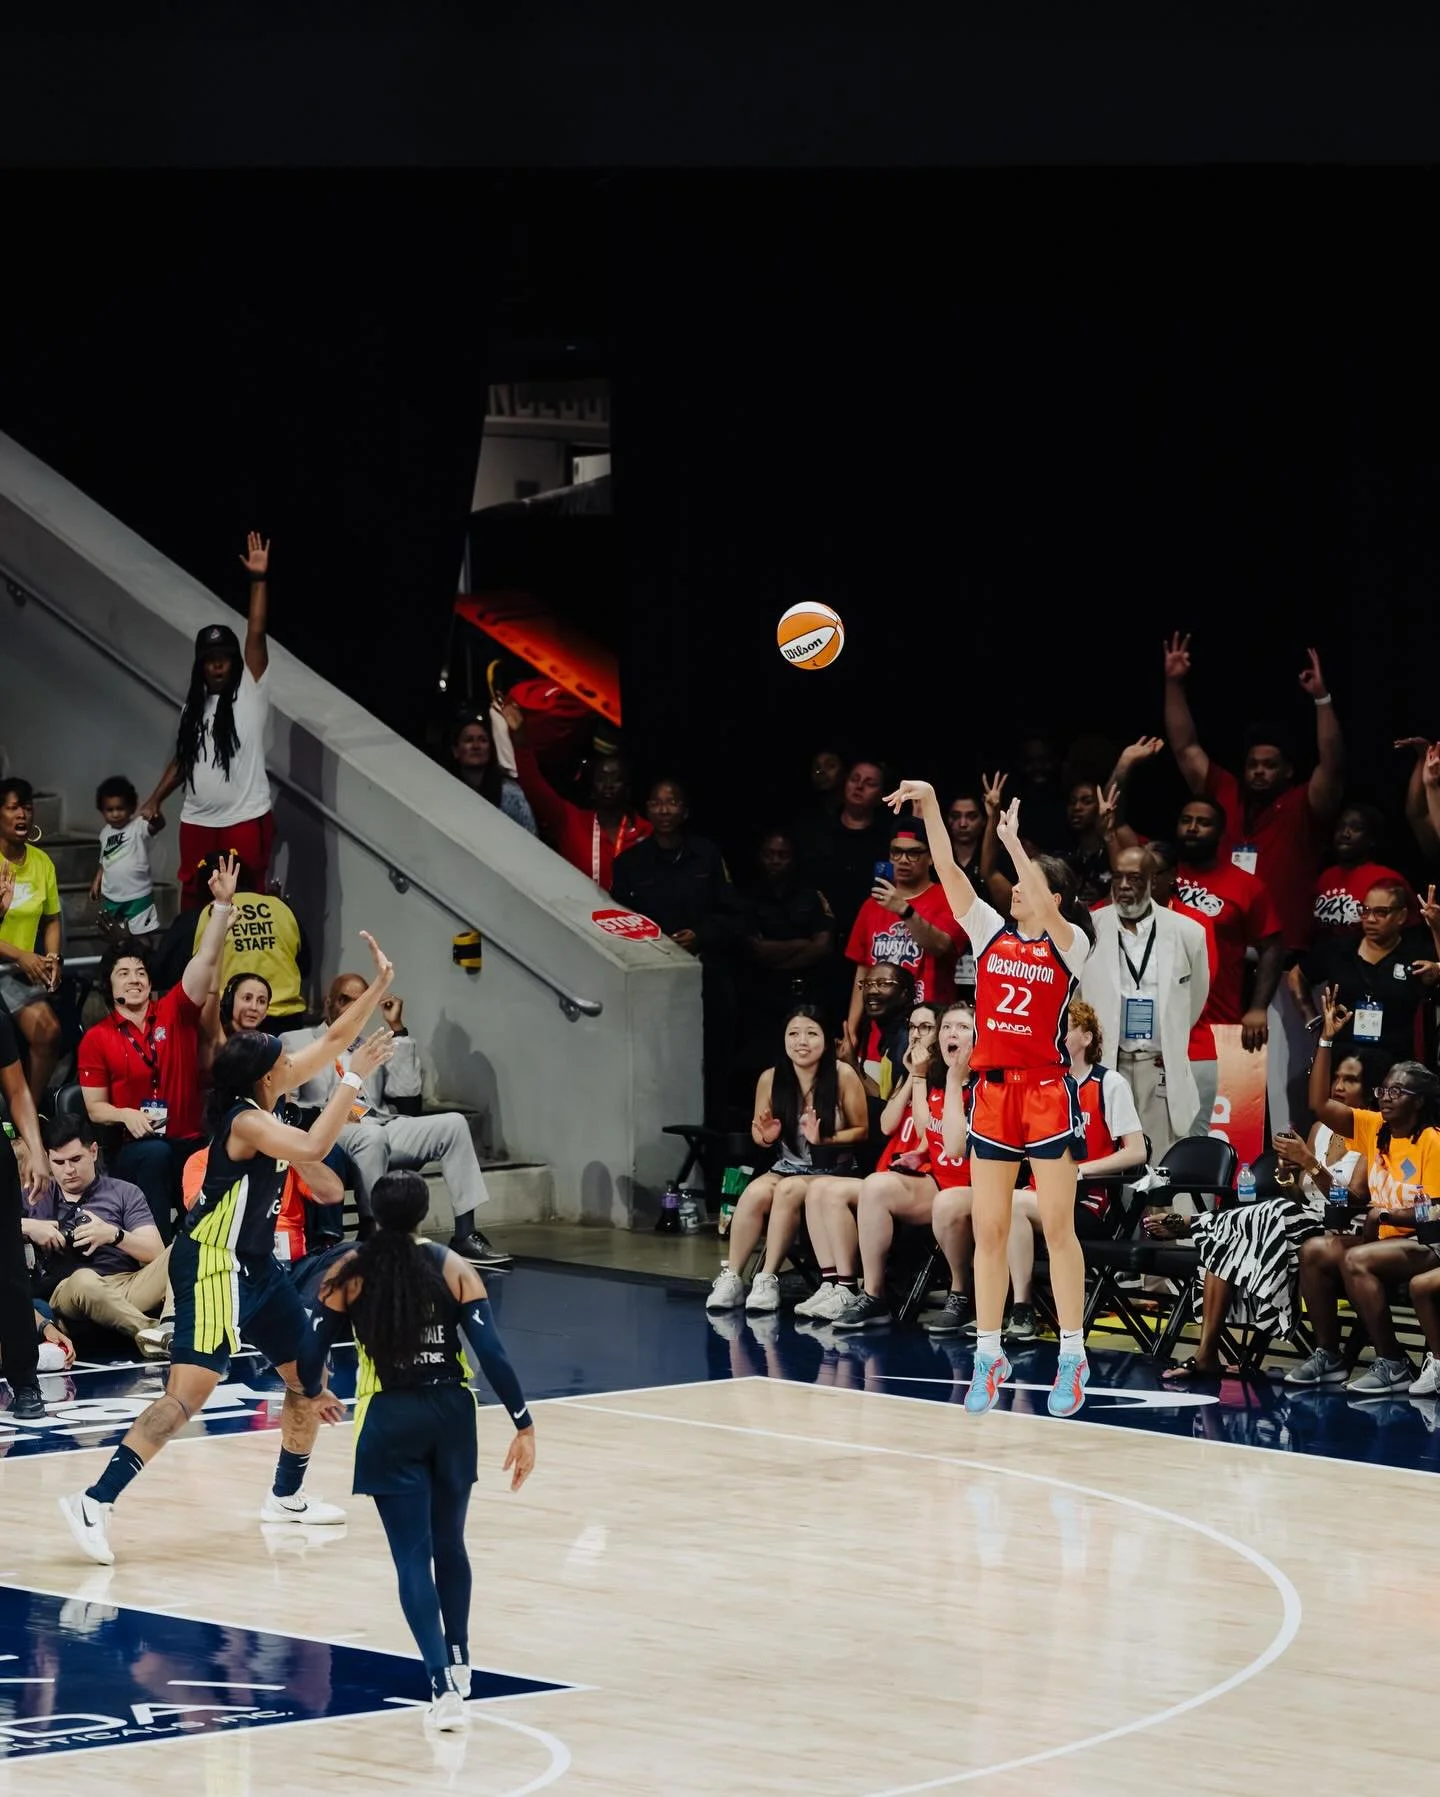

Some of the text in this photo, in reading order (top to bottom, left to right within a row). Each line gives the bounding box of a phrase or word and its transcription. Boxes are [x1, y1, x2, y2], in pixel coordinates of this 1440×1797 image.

[784, 638, 823, 659] Wilson
[105, 832, 125, 848] NIKE
[236, 903, 272, 920] SC
[232, 921, 273, 937] EVENT
[596, 915, 643, 930] STOP
[234, 936, 275, 952] STAFF
[996, 983, 1032, 1017] 22
[996, 1020, 1032, 1033] VANDA
